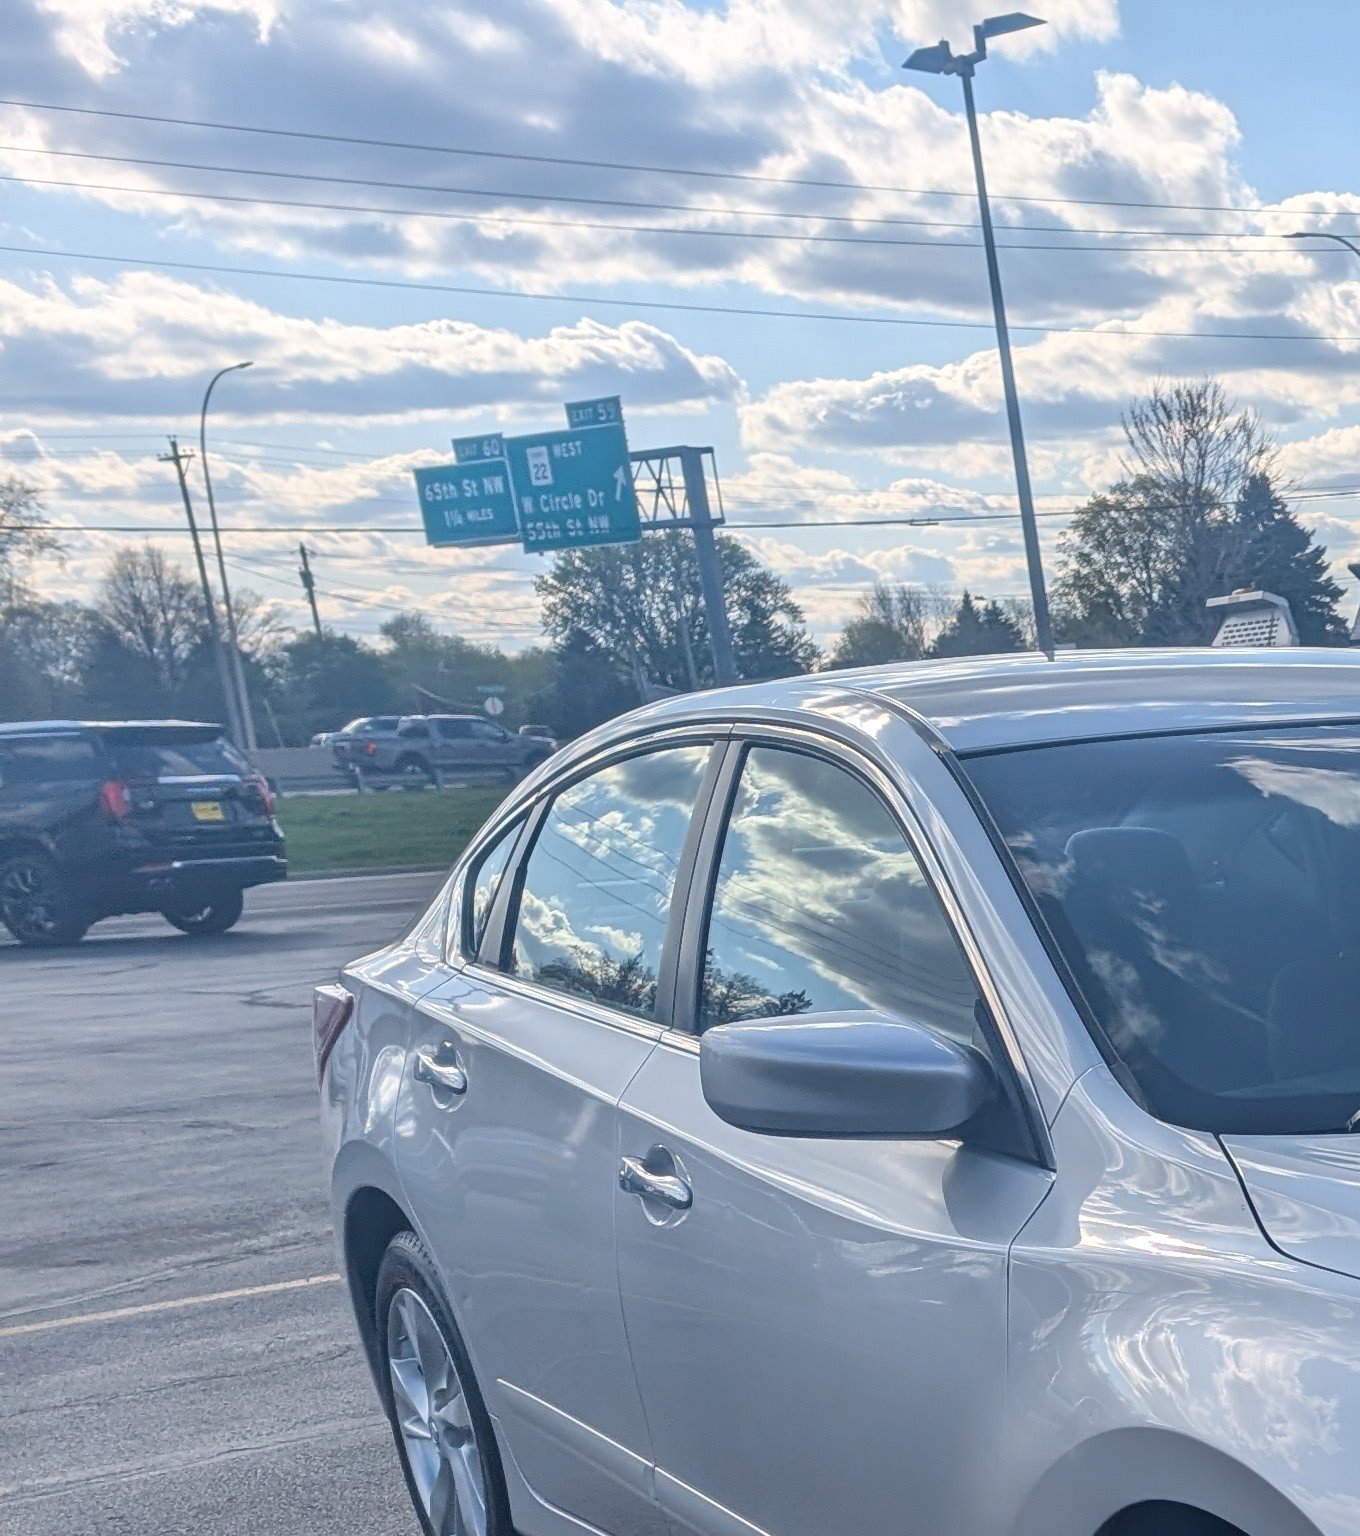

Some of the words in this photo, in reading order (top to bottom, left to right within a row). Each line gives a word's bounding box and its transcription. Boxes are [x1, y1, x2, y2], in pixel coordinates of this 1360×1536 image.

[482, 439, 501, 456] 60
[552, 441, 582, 458] WEST
[532, 463, 548, 481] 22
[425, 482, 458, 502] 65th
[462, 479, 479, 497] St
[482, 475, 504, 496] NW
[540, 491, 582, 513] Circle
[587, 489, 604, 508] Dr
[526, 521, 561, 541] 55th
[566, 518, 583, 537] St
[587, 514, 611, 535] NW
